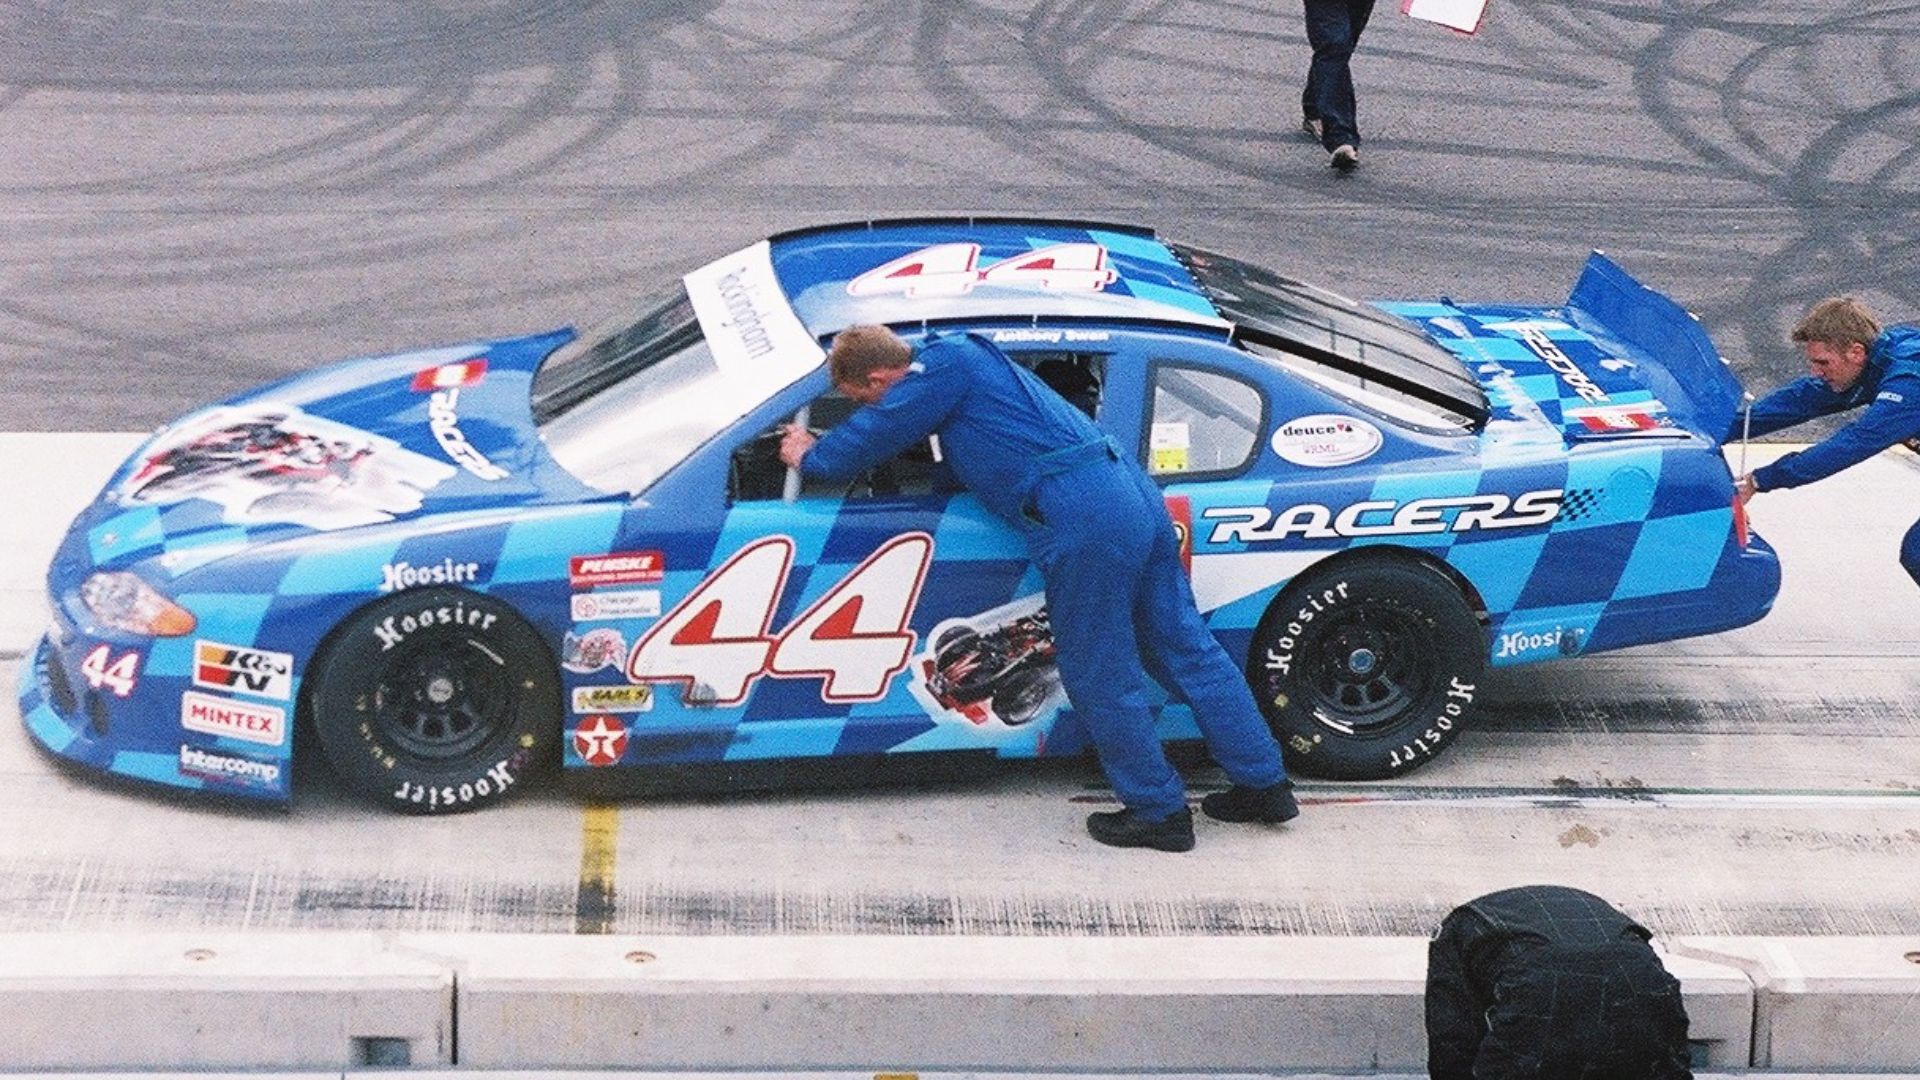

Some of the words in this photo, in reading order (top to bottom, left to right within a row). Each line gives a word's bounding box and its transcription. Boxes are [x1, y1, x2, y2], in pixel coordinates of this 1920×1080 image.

[846, 243, 1117, 298] 44
[1283, 425, 1336, 436] deuce
[1202, 489, 1565, 542] RACERS
[379, 558, 480, 592] Hoosier
[579, 555, 655, 574] PENSKE
[373, 601, 498, 651] Hoosier
[628, 532, 934, 705] 44
[1265, 581, 1348, 676] Hoosier
[1496, 625, 1585, 658] Hoosi
[81, 644, 141, 695] 44
[191, 703, 273, 733] MINTEX
[1390, 676, 1476, 768] Hoosier
[180, 744, 279, 782] Intercomp
[394, 760, 515, 810] Hoosier
